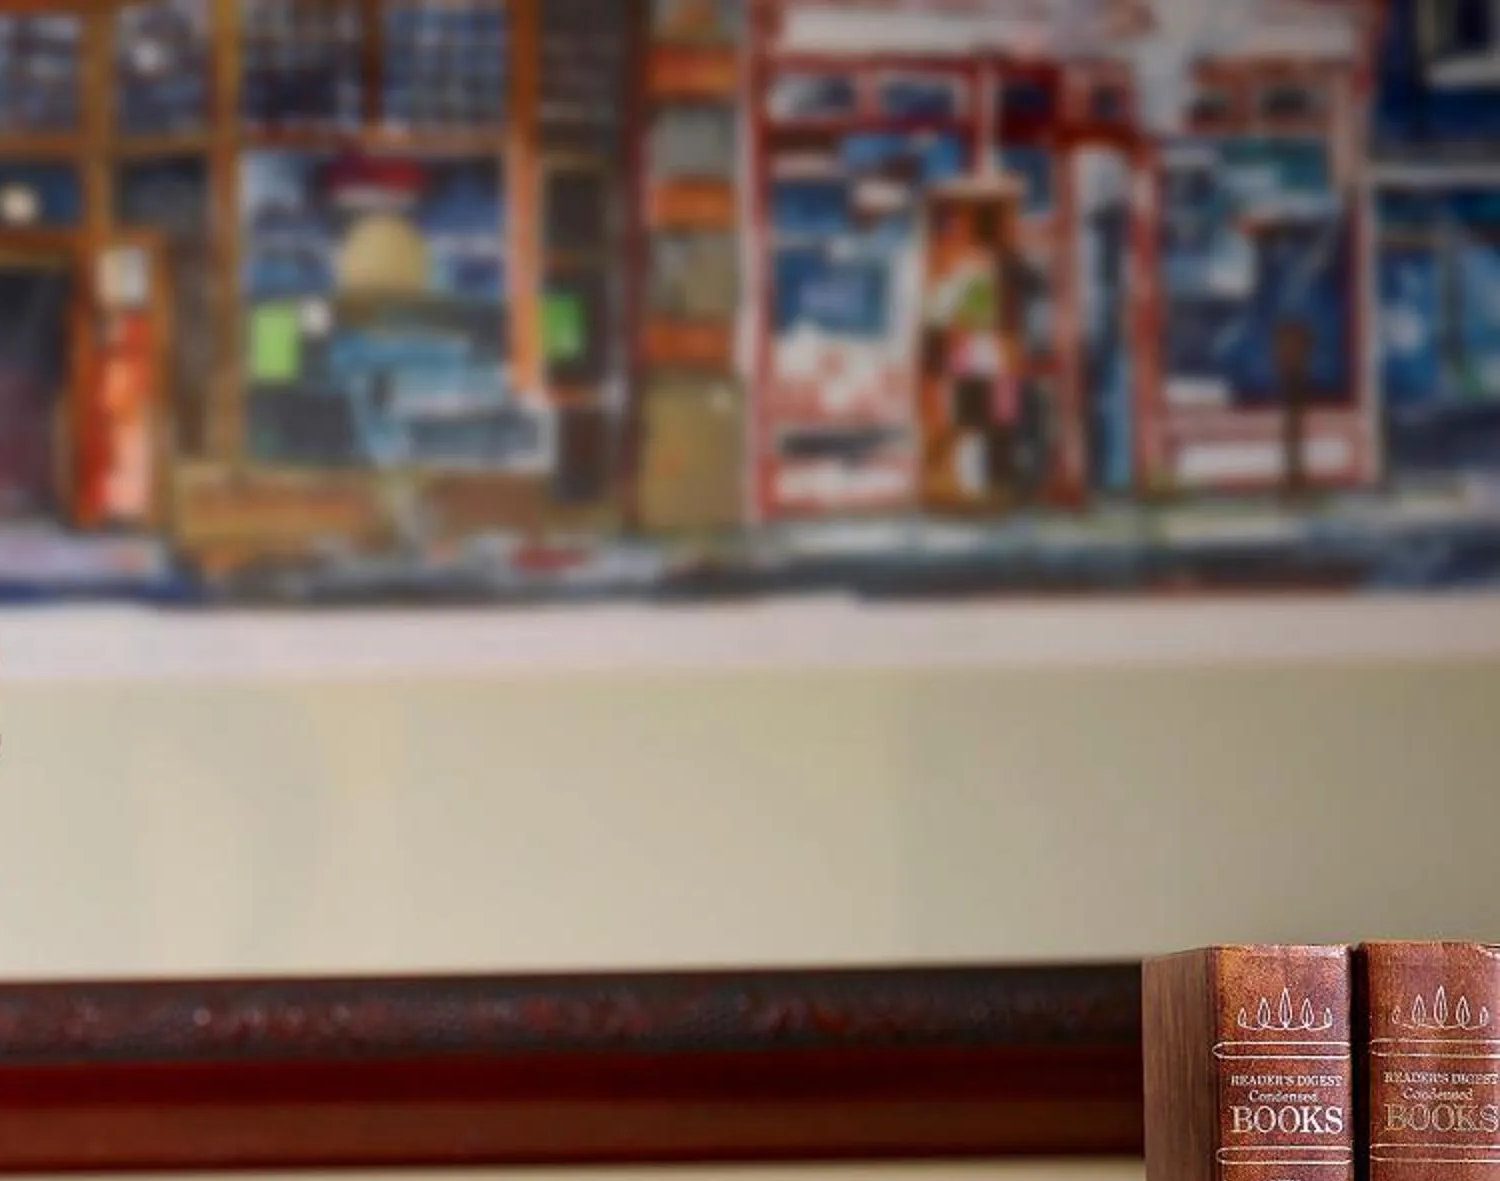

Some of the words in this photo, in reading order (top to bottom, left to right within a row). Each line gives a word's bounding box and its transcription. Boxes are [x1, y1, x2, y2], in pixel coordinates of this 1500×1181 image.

[1231, 1075, 1293, 1087] READER'S
[1297, 1075, 1343, 1087] DIGEST
[1451, 1073, 1499, 1085] DIGEST
[1249, 1091, 1317, 1103] Condensed
[1230, 1106, 1343, 1133] BOOKS
[1384, 1103, 1499, 1132] BOOKS
